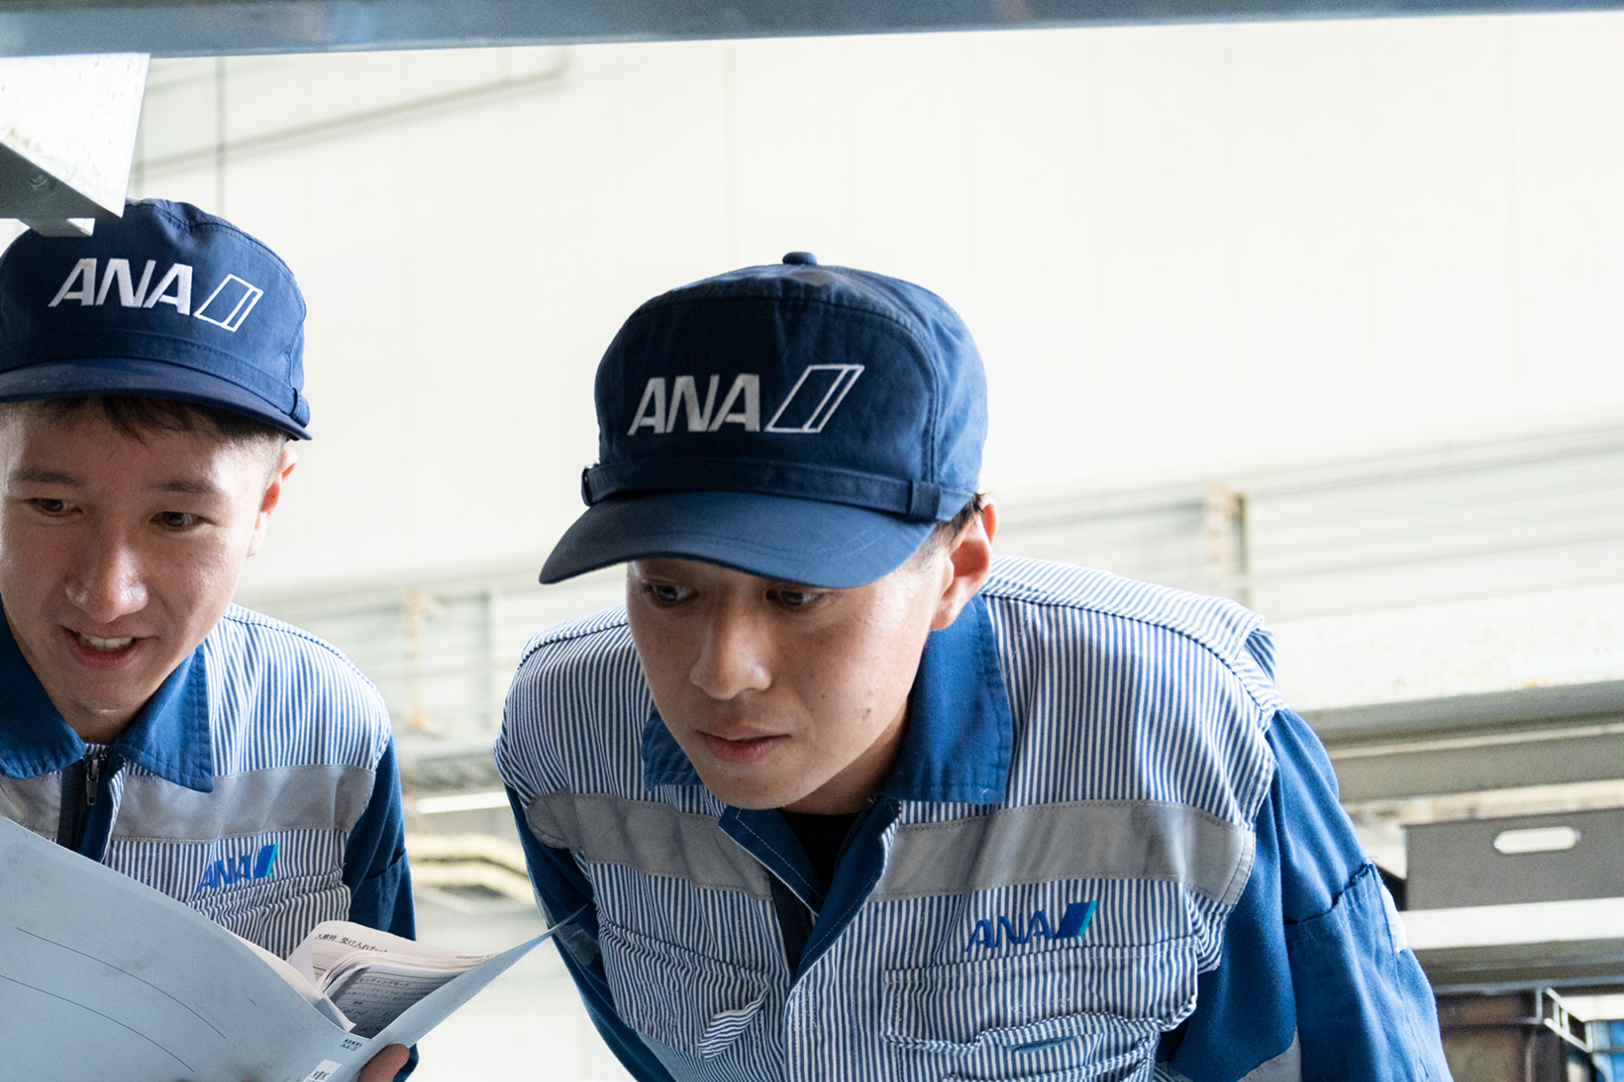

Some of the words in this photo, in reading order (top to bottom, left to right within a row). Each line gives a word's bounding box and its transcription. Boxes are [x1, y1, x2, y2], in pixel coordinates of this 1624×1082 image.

[48, 258, 193, 316] ANA
[627, 373, 761, 436] ANA
[197, 855, 252, 892] ANA
[966, 909, 1052, 952] ANA
